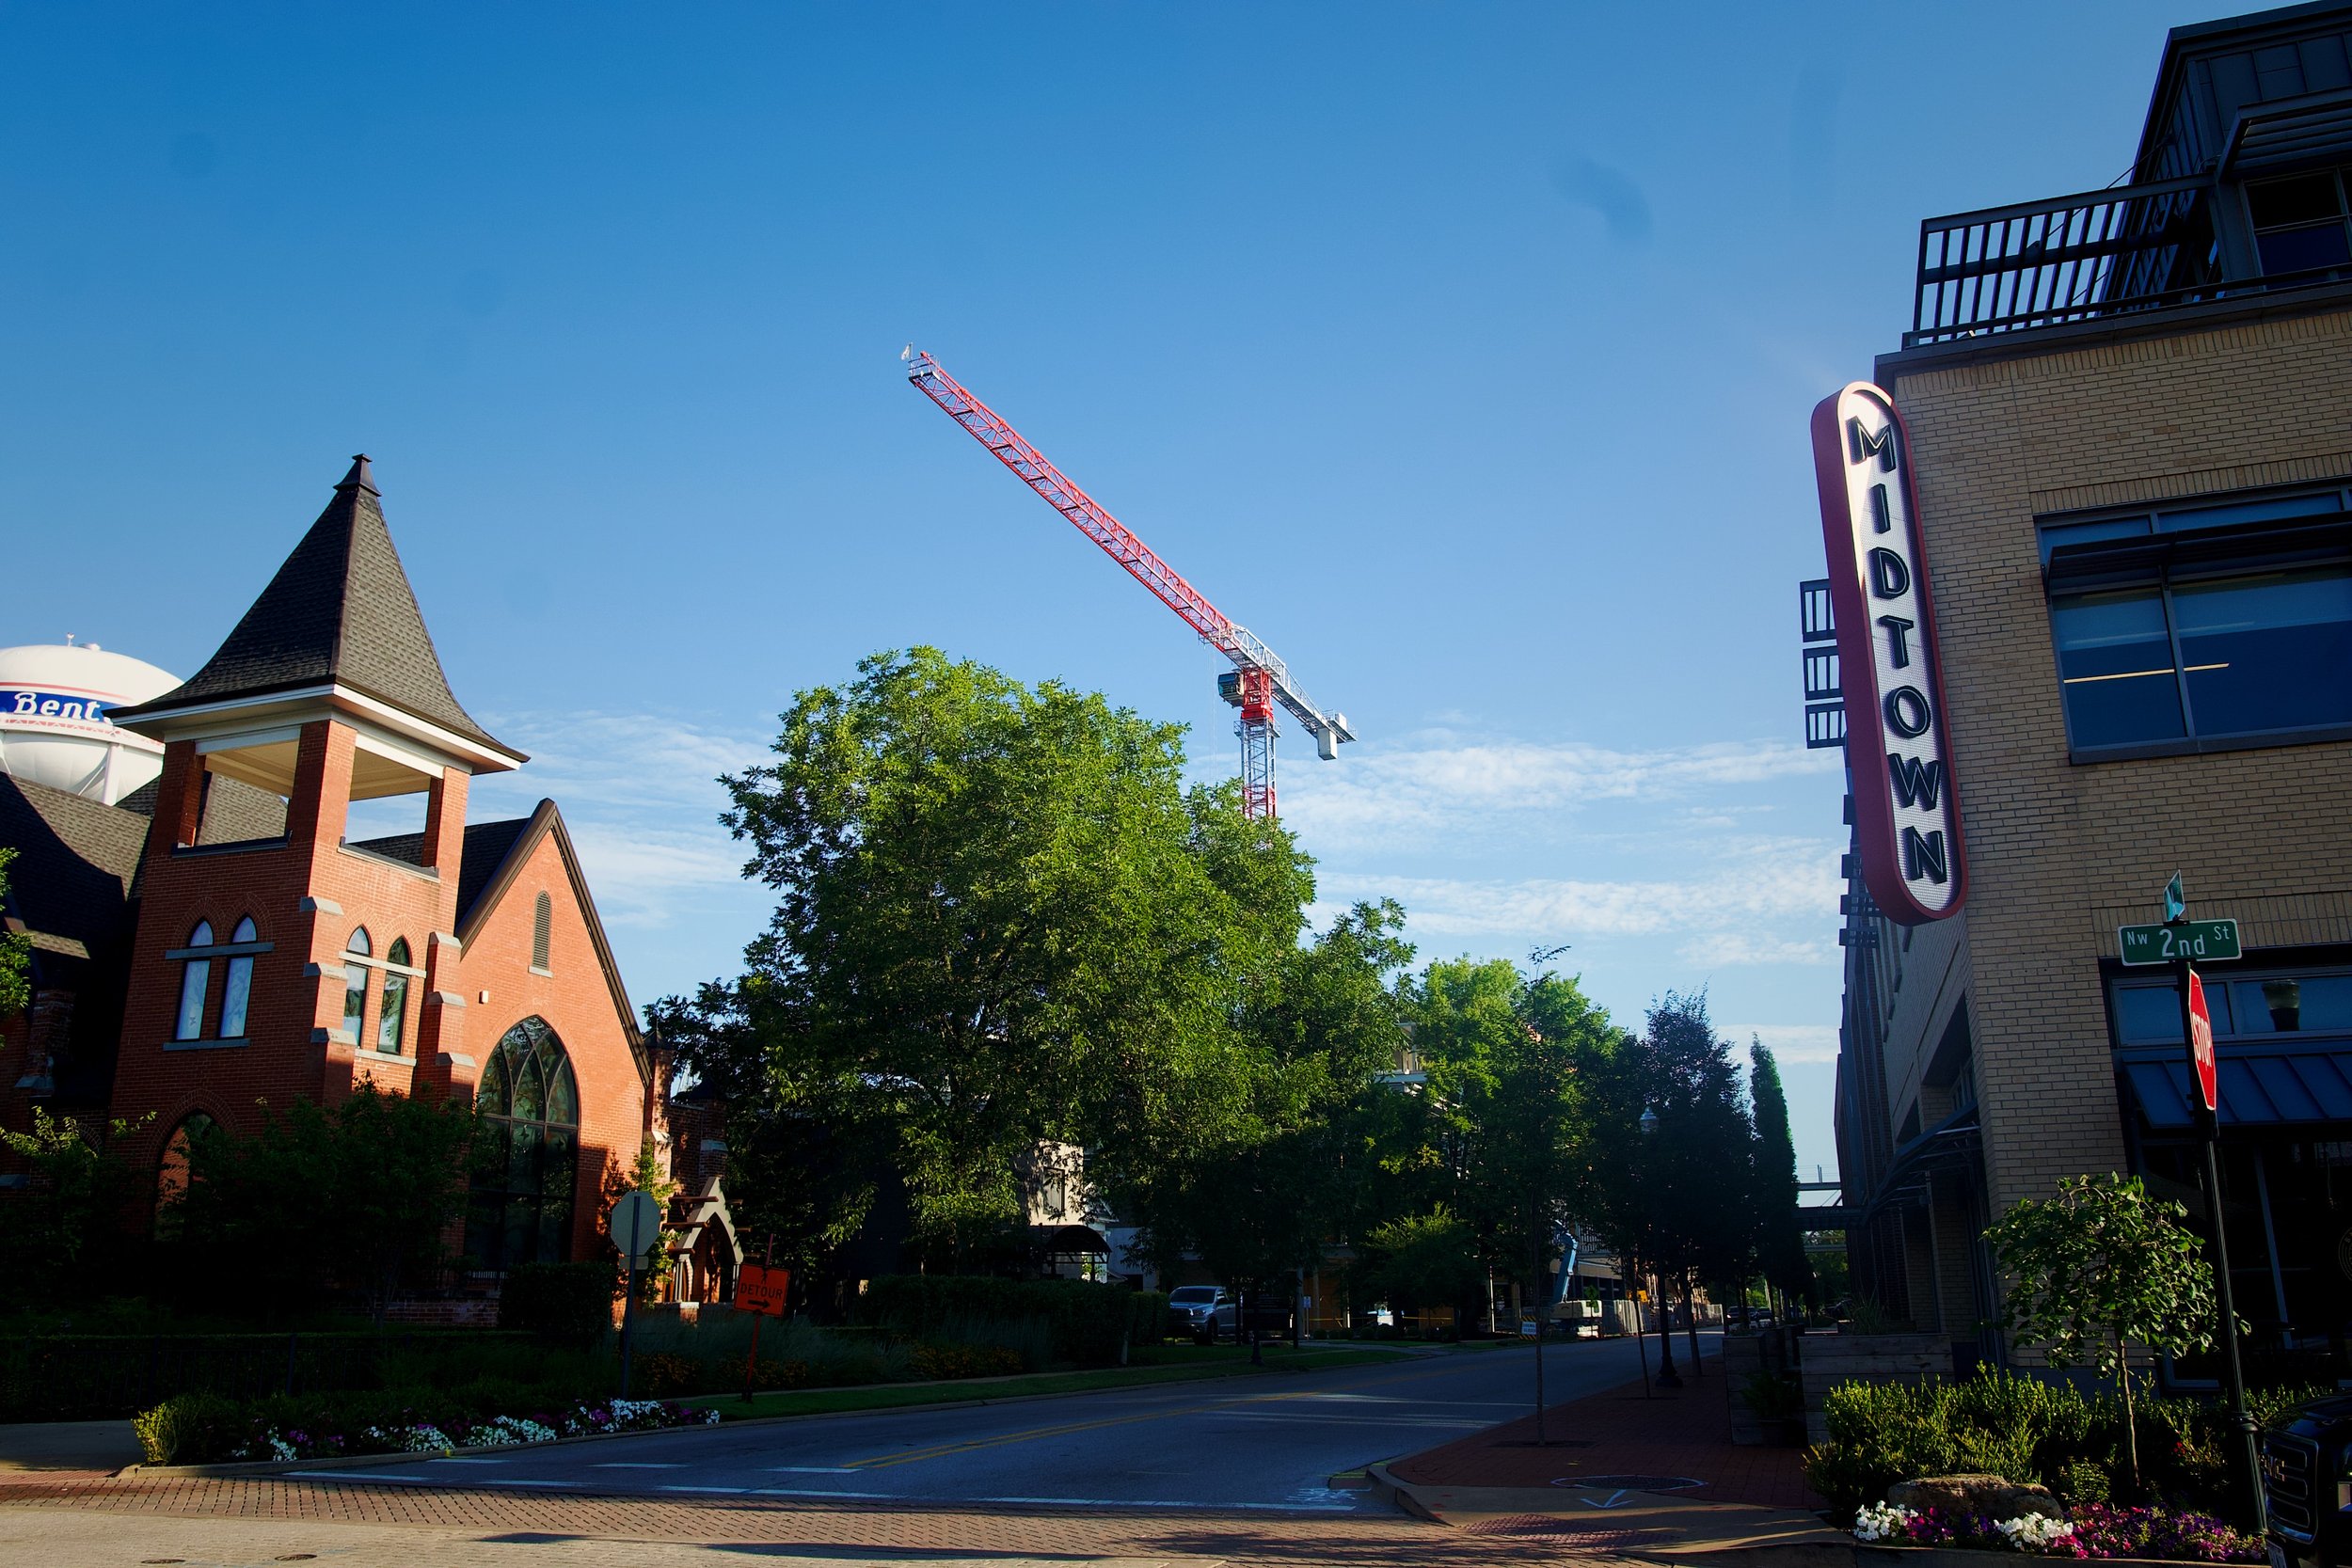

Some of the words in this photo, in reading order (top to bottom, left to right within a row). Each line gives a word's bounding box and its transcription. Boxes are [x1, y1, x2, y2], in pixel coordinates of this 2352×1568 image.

[1846, 415, 1947, 884] MIDTOWN
[2159, 928, 2206, 957] 2nd
[2214, 926, 2230, 941] St
[2192, 1011, 2213, 1069] STOP
[739, 1282, 784, 1299] DETOUR
